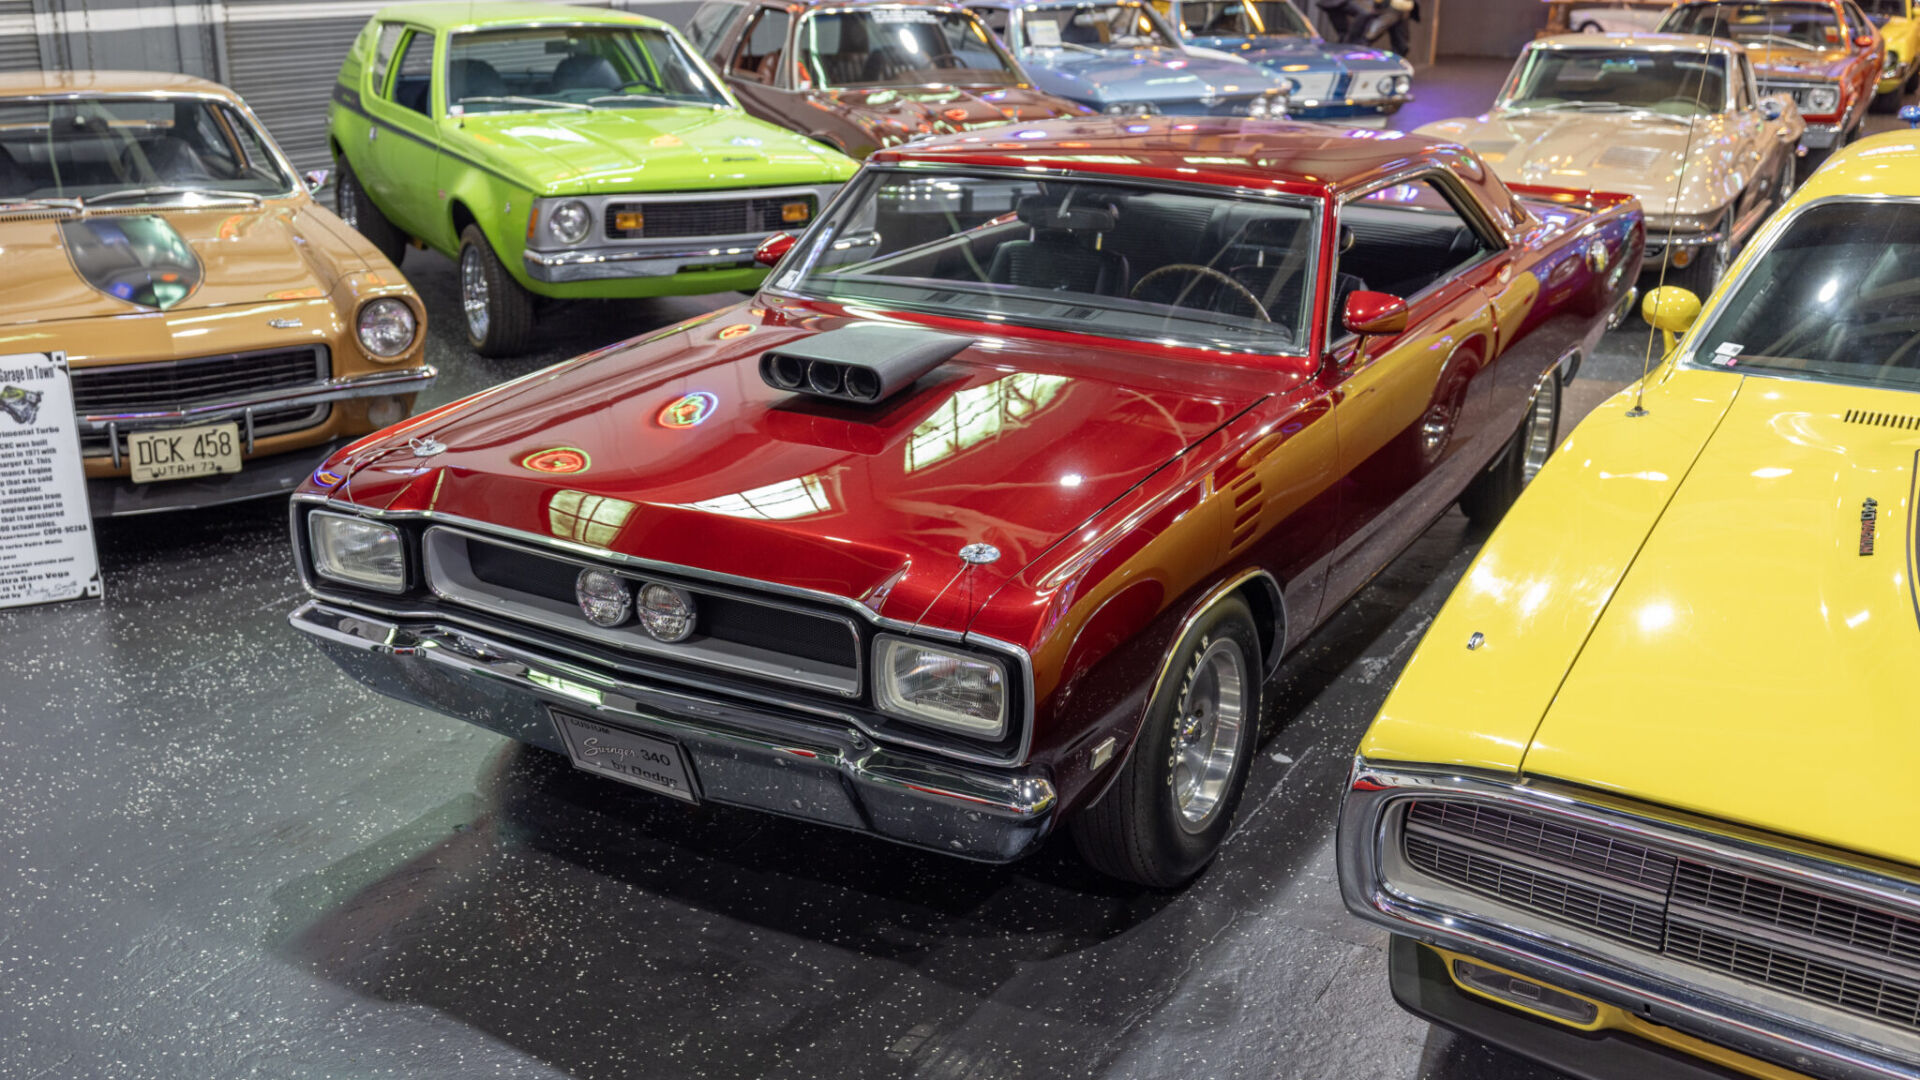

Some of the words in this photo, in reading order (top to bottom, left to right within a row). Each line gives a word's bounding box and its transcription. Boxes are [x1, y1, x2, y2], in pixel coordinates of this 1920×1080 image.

[36, 426, 60, 435] Turbo
[137, 436, 184, 465] DCK
[194, 432, 232, 458] 458
[28, 467, 52, 475] Engine
[158, 464, 195, 476] UTAH
[6, 478, 20, 486] that
[1, 506, 25, 514] engine
[43, 502, 54, 510] put
[1861, 497, 1878, 520] 440
[25, 510, 64, 520] unrestored
[12, 522, 34, 531] actual
[1860, 520, 1875, 556] MAGNUM
[584, 737, 636, 762] Swinger
[640, 748, 670, 766] 340
[612, 760, 627, 774] by
[632, 765, 678, 786] Dodge
